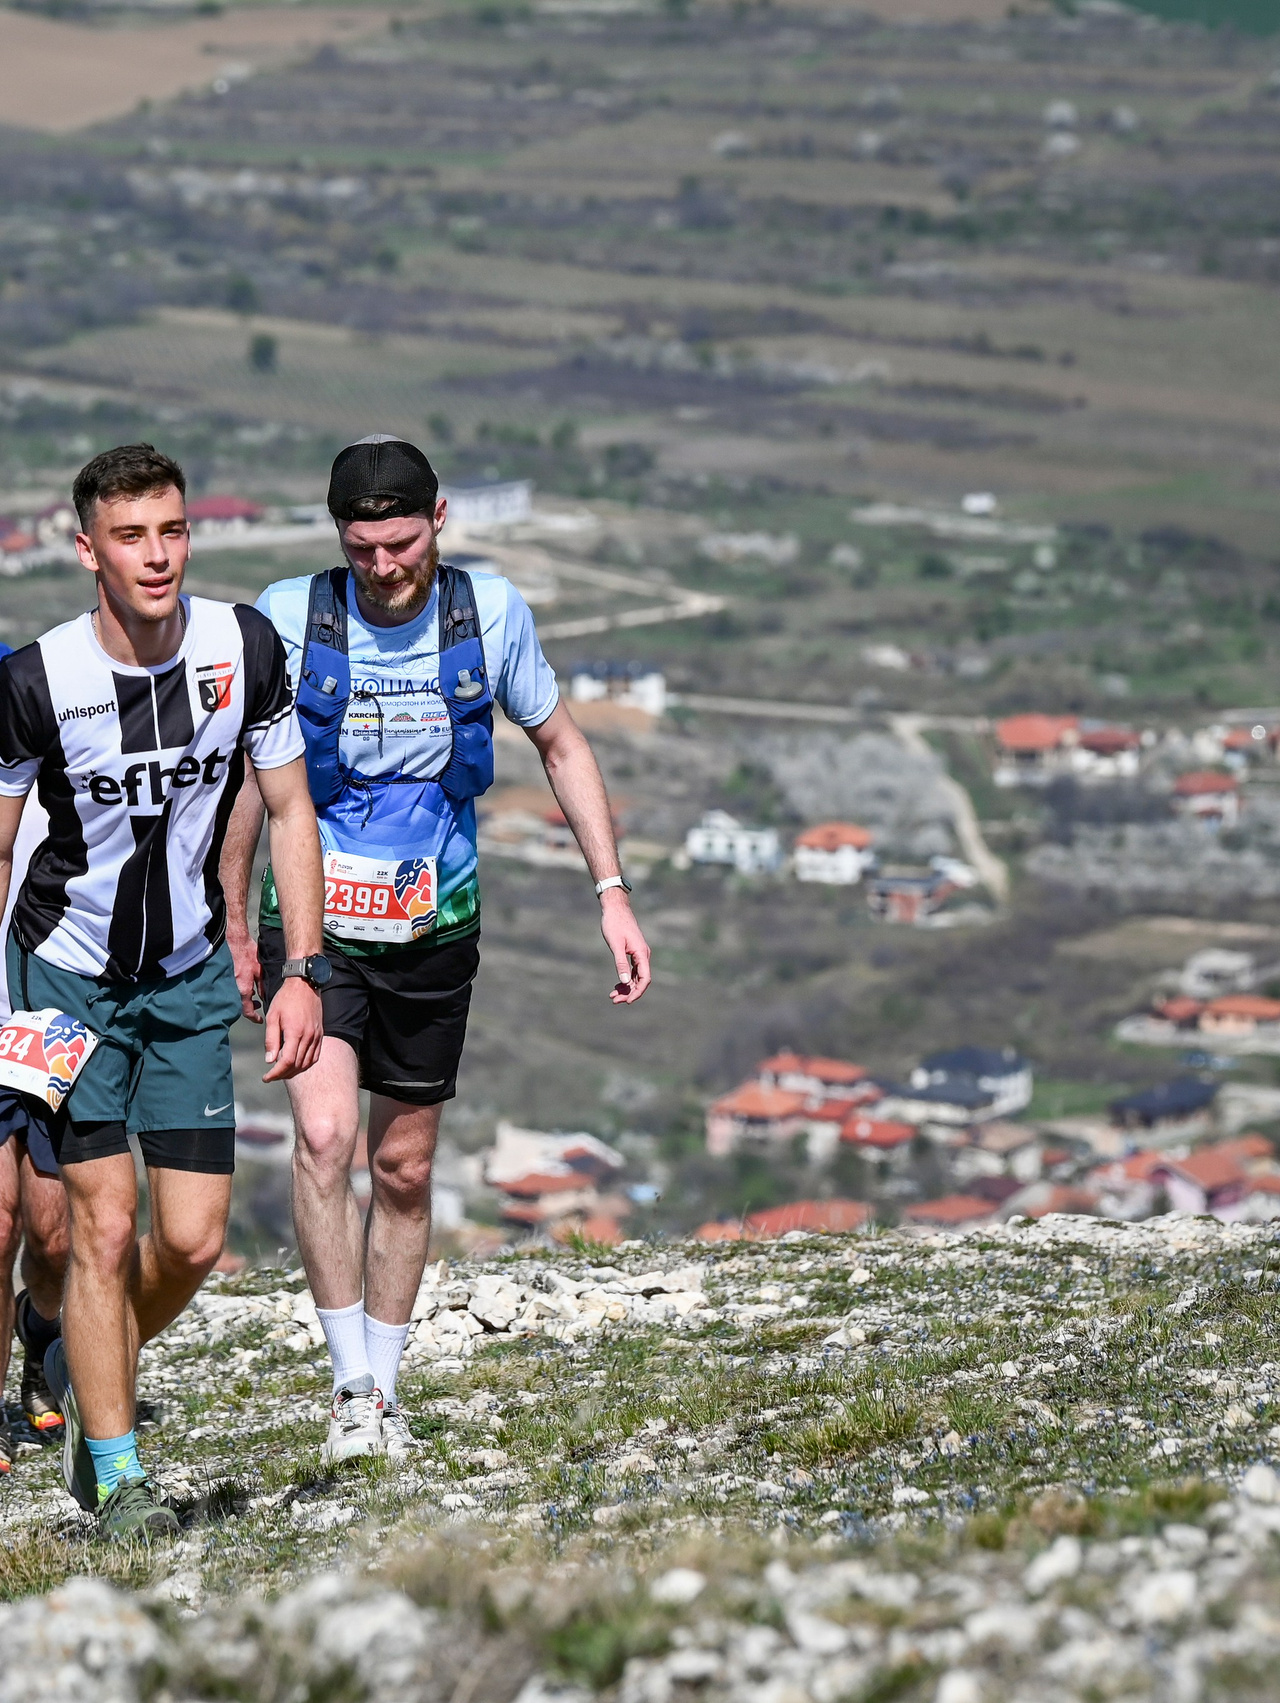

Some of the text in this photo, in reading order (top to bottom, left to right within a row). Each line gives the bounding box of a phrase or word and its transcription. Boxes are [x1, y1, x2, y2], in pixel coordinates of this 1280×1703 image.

[58, 700, 116, 722] uhlsport
[89, 747, 226, 807] efbet
[324, 881, 390, 916] 2399
